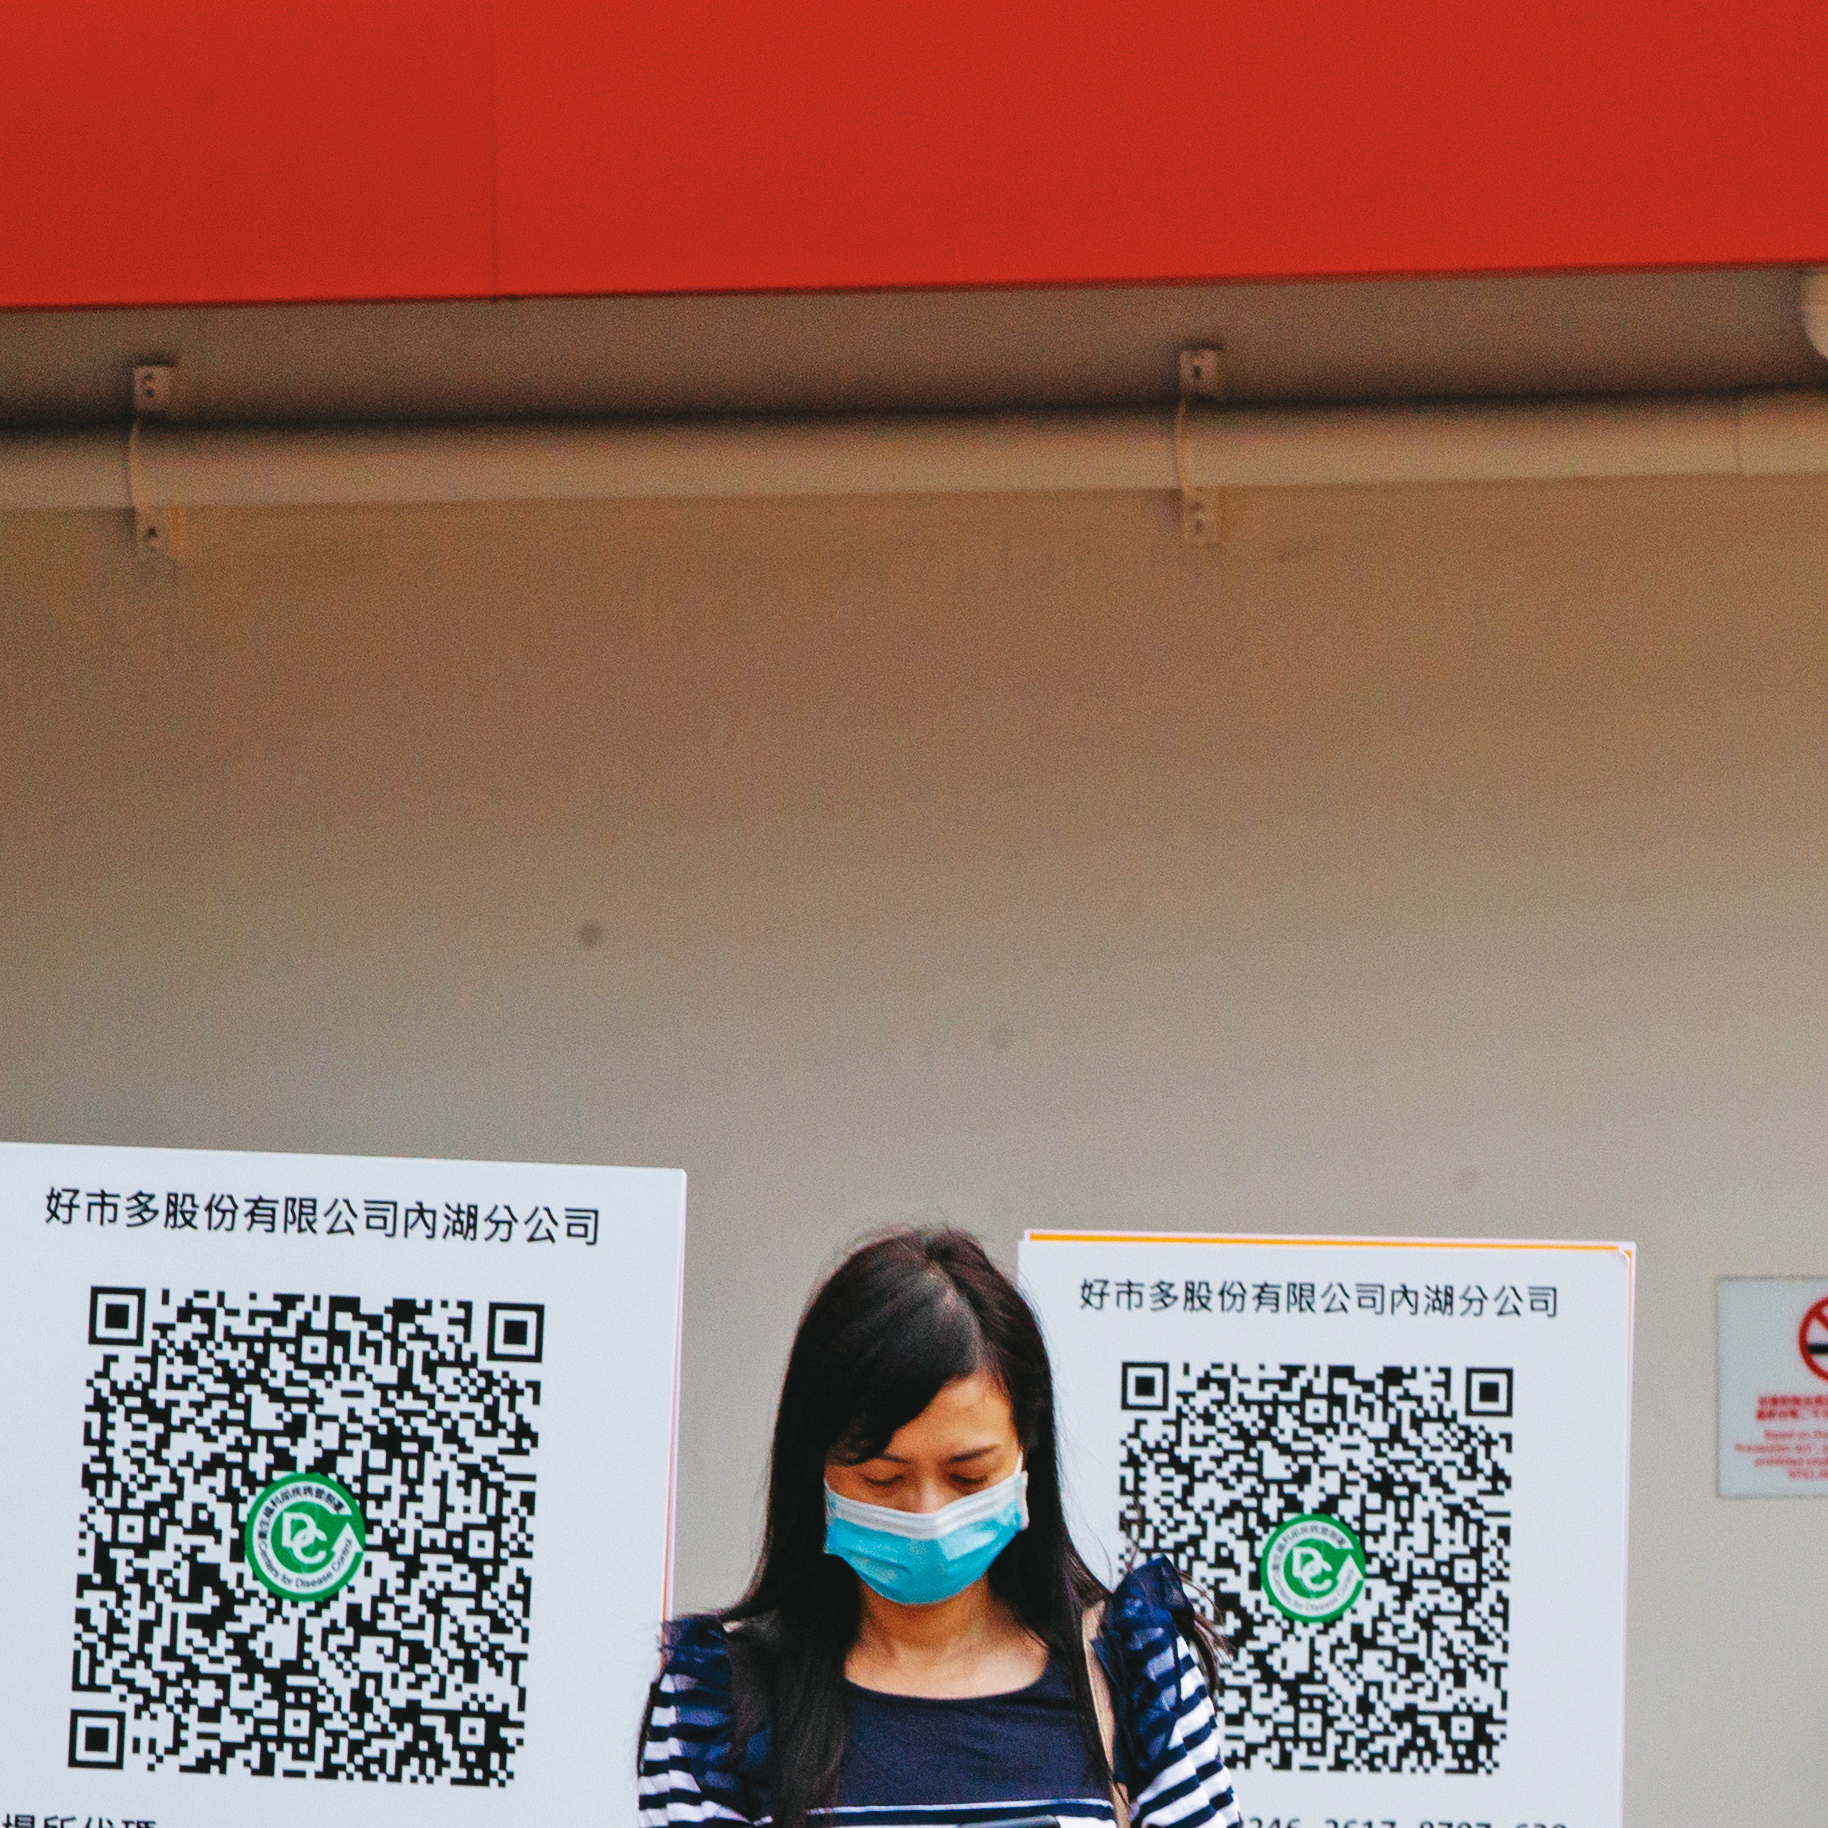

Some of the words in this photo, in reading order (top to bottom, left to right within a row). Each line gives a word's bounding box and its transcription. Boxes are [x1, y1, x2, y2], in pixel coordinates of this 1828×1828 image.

[44, 1185, 600, 1247] 好市多股份有限公司內湖分公司
[1078, 1277, 1560, 1320] 好市多股份有限公司內湖分公司
